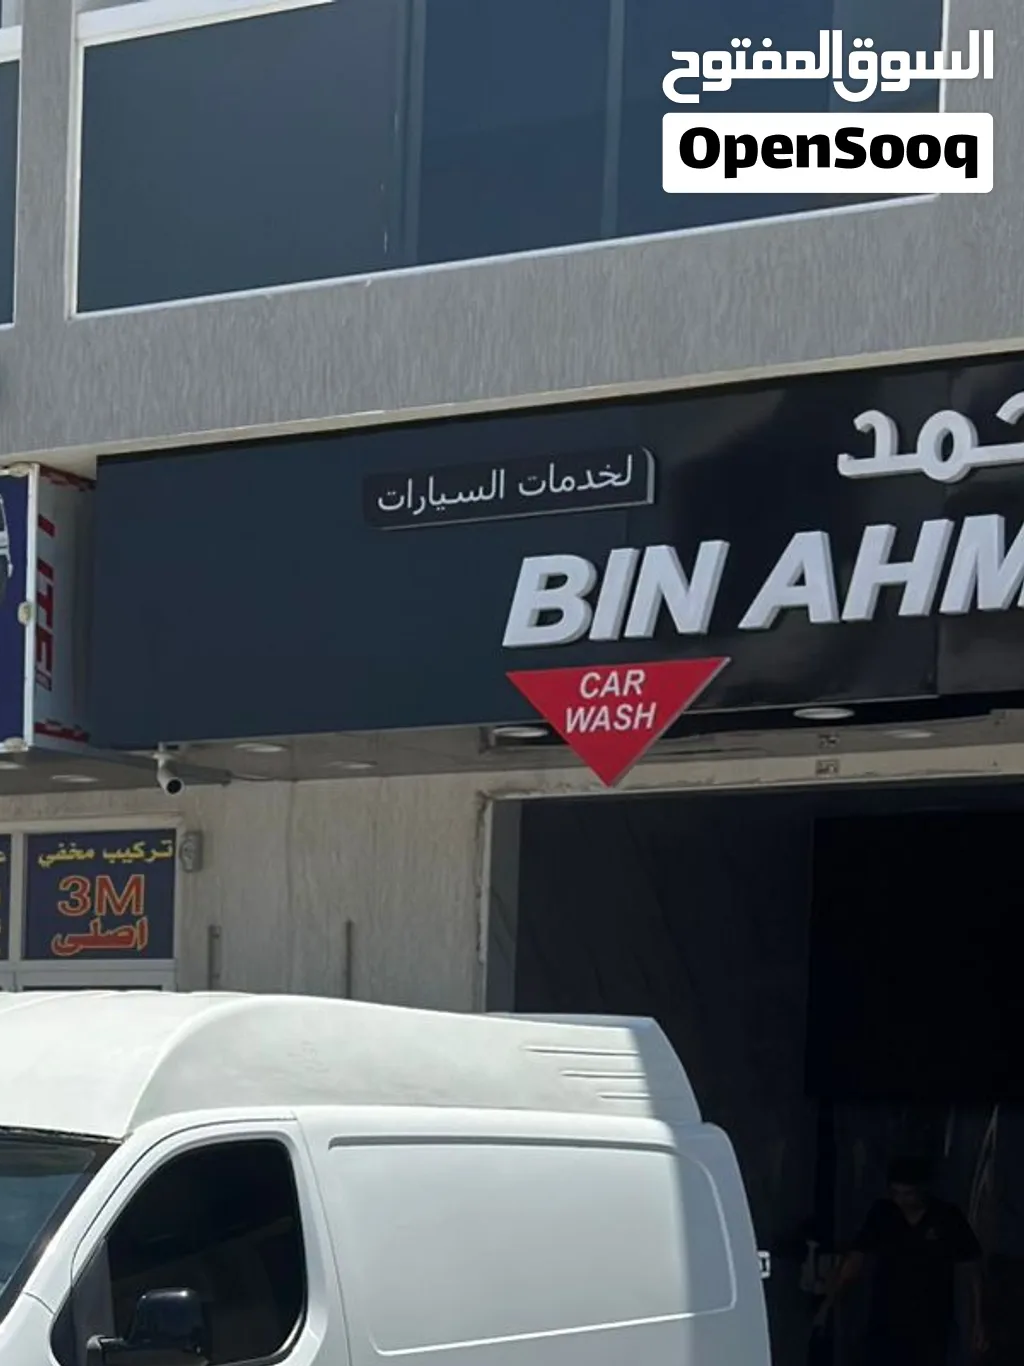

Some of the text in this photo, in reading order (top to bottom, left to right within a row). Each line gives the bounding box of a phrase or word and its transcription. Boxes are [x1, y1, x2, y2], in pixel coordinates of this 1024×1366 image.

[378, 454, 632, 515] لخدمات السيارات
[502, 513, 1024, 648] BIN AHM
[580, 669, 646, 699] CAR
[565, 702, 657, 733] WASH
[102, 840, 173, 864] تركيب
[58, 874, 145, 916] 3M
